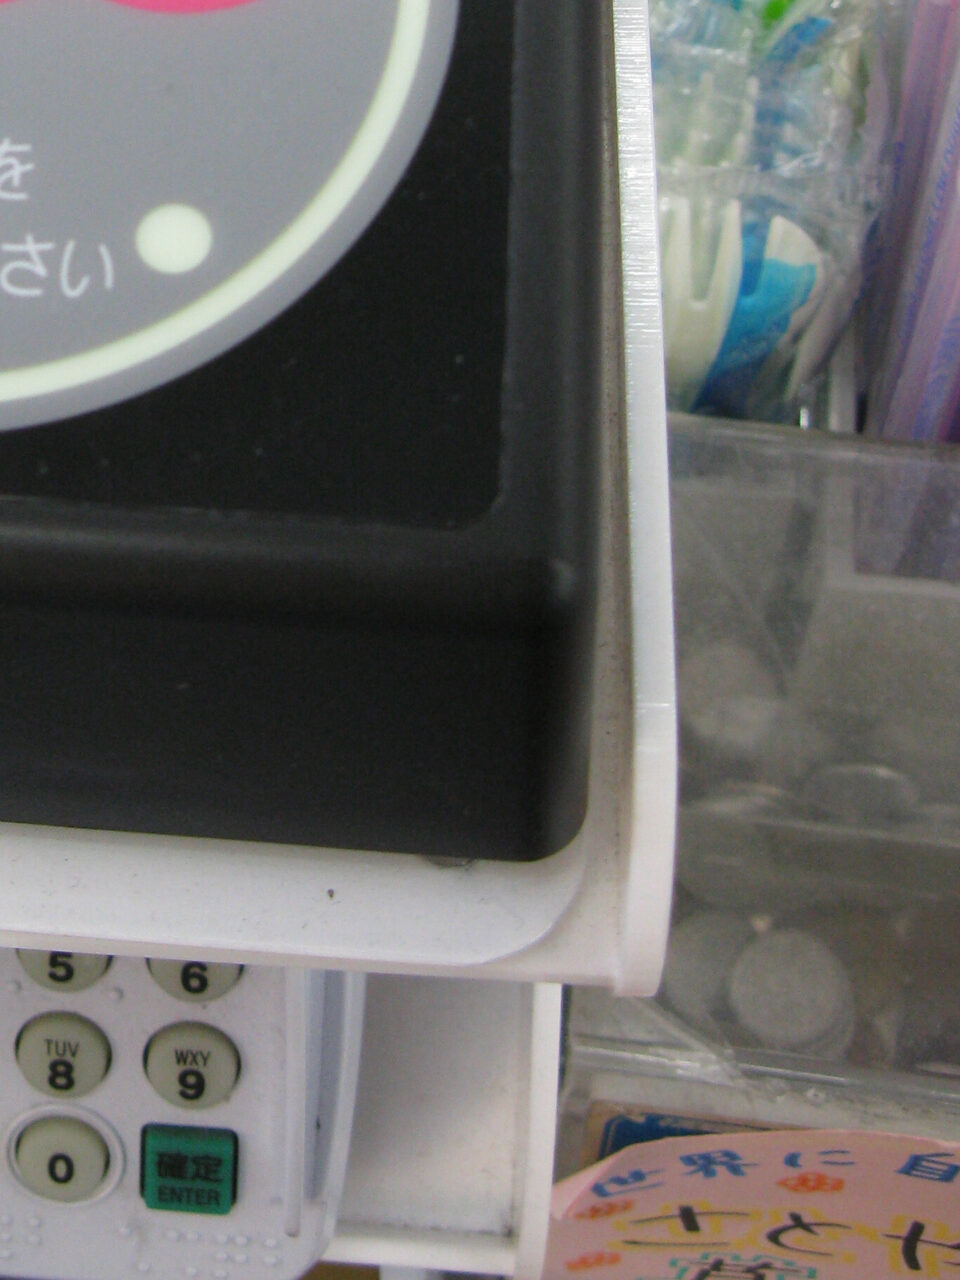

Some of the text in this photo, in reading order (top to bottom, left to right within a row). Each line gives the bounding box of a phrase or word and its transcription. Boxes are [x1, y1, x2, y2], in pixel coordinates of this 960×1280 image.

[48, 951, 74, 983] 5
[181, 960, 209, 994] 6
[45, 1038, 80, 1058] TUV
[175, 1049, 211, 1068] WXY
[48, 1059, 75, 1091] 8
[178, 1068, 206, 1101] 9
[48, 1153, 74, 1184] 0
[158, 1186, 221, 1206] ENTER
